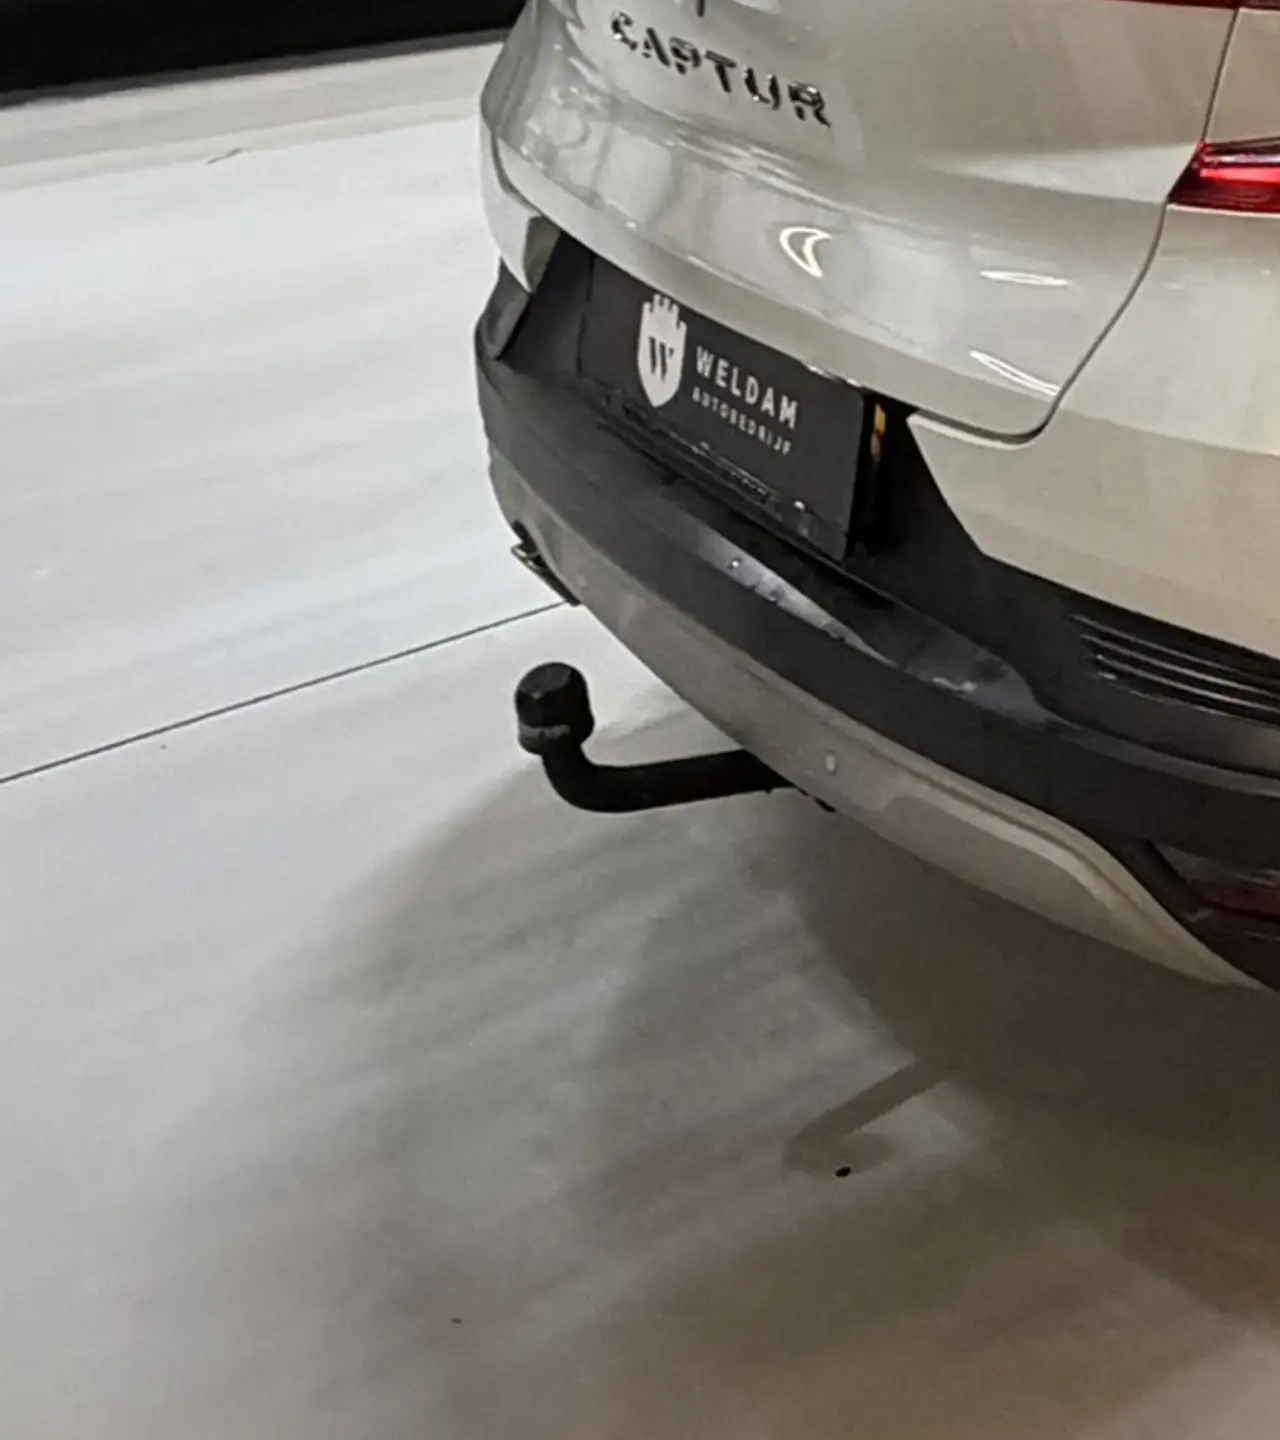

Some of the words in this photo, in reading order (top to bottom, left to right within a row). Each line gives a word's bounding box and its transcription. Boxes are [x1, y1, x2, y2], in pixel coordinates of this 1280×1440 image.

[611, 11, 832, 128] CAPTUR
[691, 385, 793, 456] AUTOBEDRIJF
[696, 344, 799, 430] WELDAM
